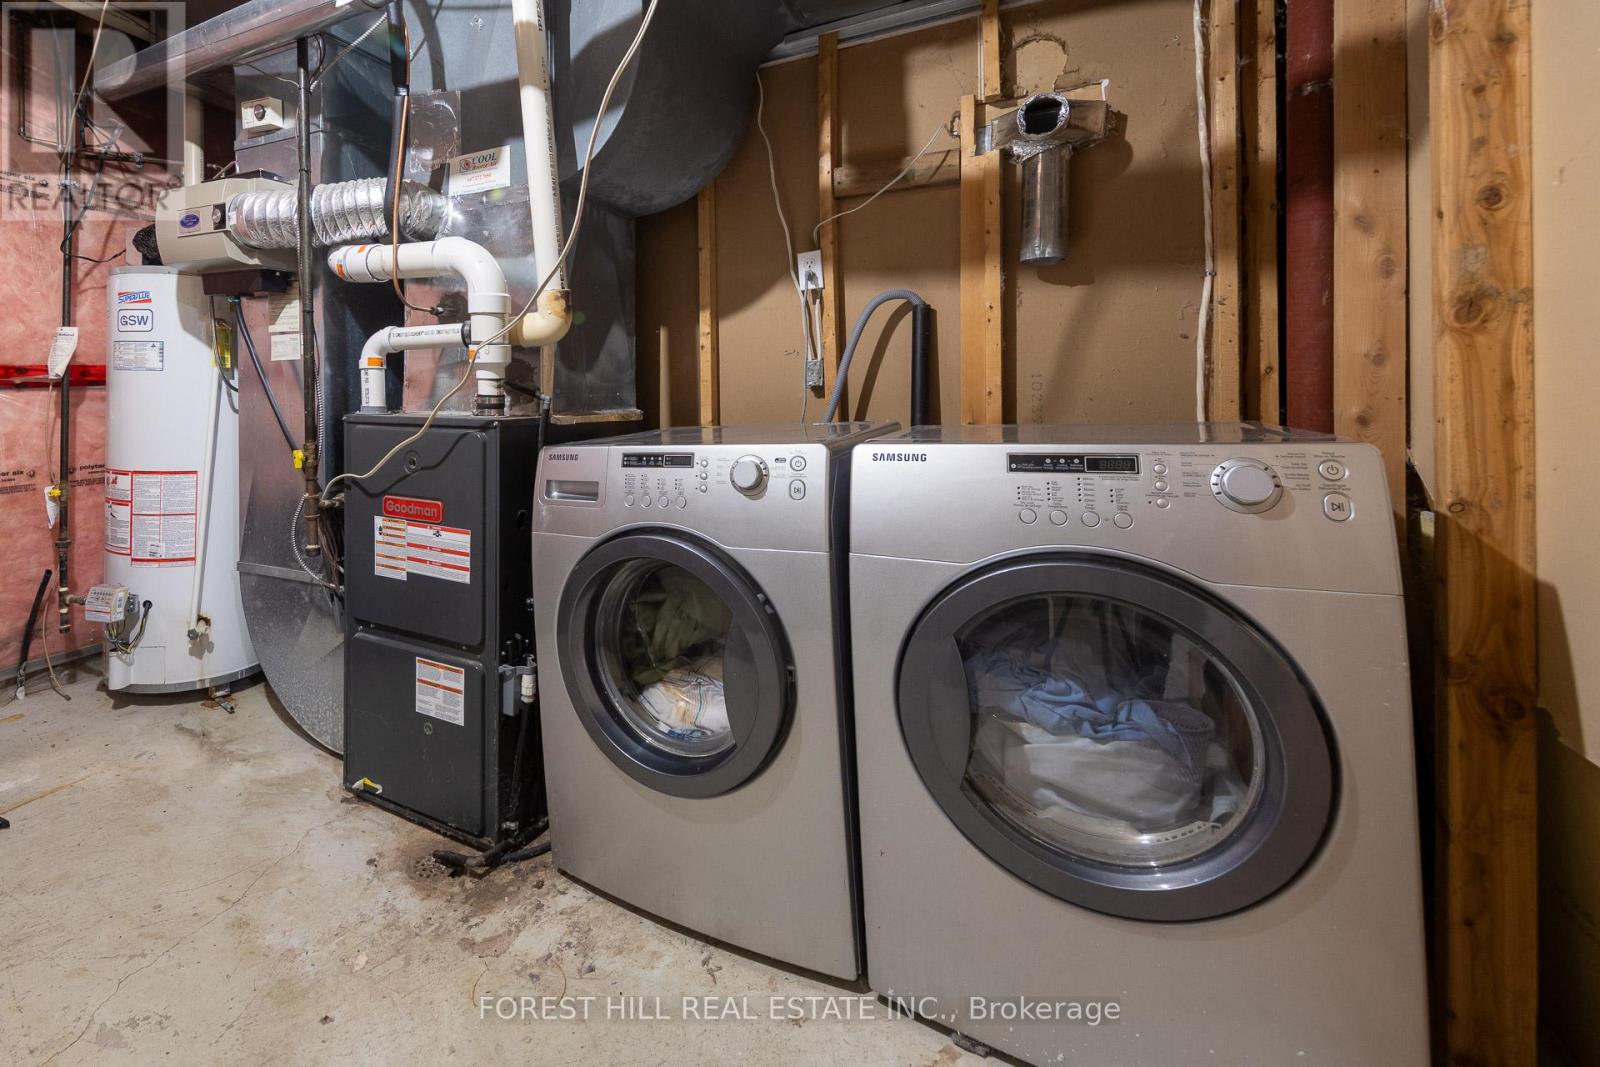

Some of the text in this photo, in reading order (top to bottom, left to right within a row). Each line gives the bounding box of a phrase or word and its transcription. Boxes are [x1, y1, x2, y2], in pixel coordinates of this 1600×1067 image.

[119, 315, 149, 326] GSW
[548, 453, 579, 461] SAMSUNG
[872, 452, 927, 462] SAMSUNG
[386, 500, 438, 517] Goodman
